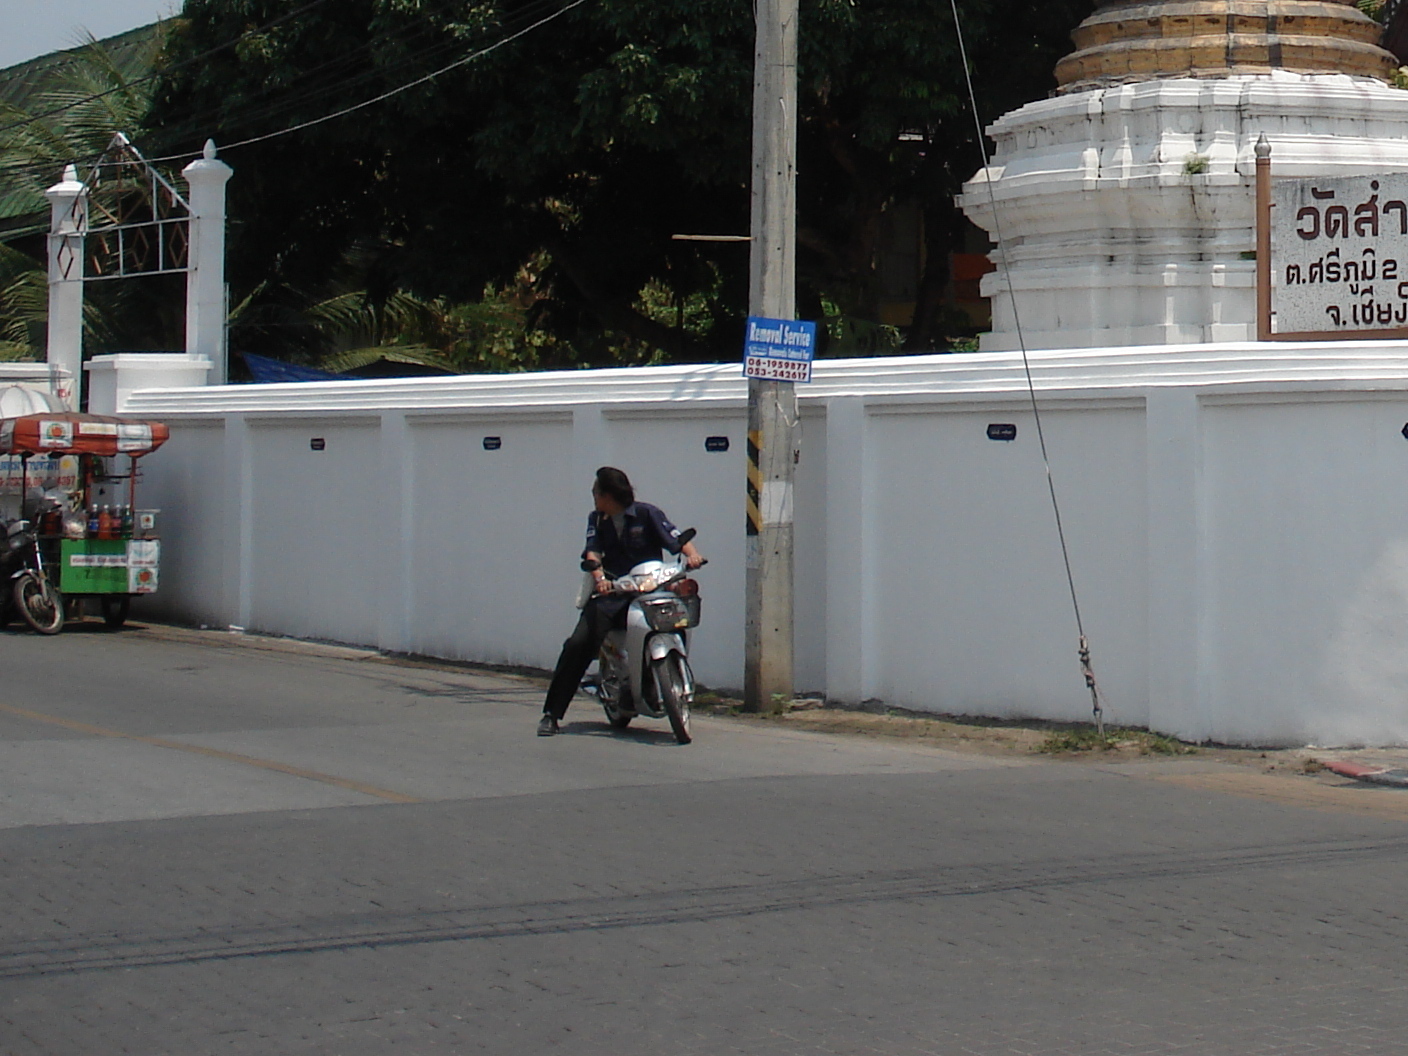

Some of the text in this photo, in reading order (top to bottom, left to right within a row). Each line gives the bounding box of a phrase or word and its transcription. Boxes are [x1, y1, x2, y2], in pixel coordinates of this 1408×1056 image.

[749, 322, 811, 347] Removal Service
[748, 357, 808, 371] 06-1959877
[747, 367, 807, 380] 053-242617
